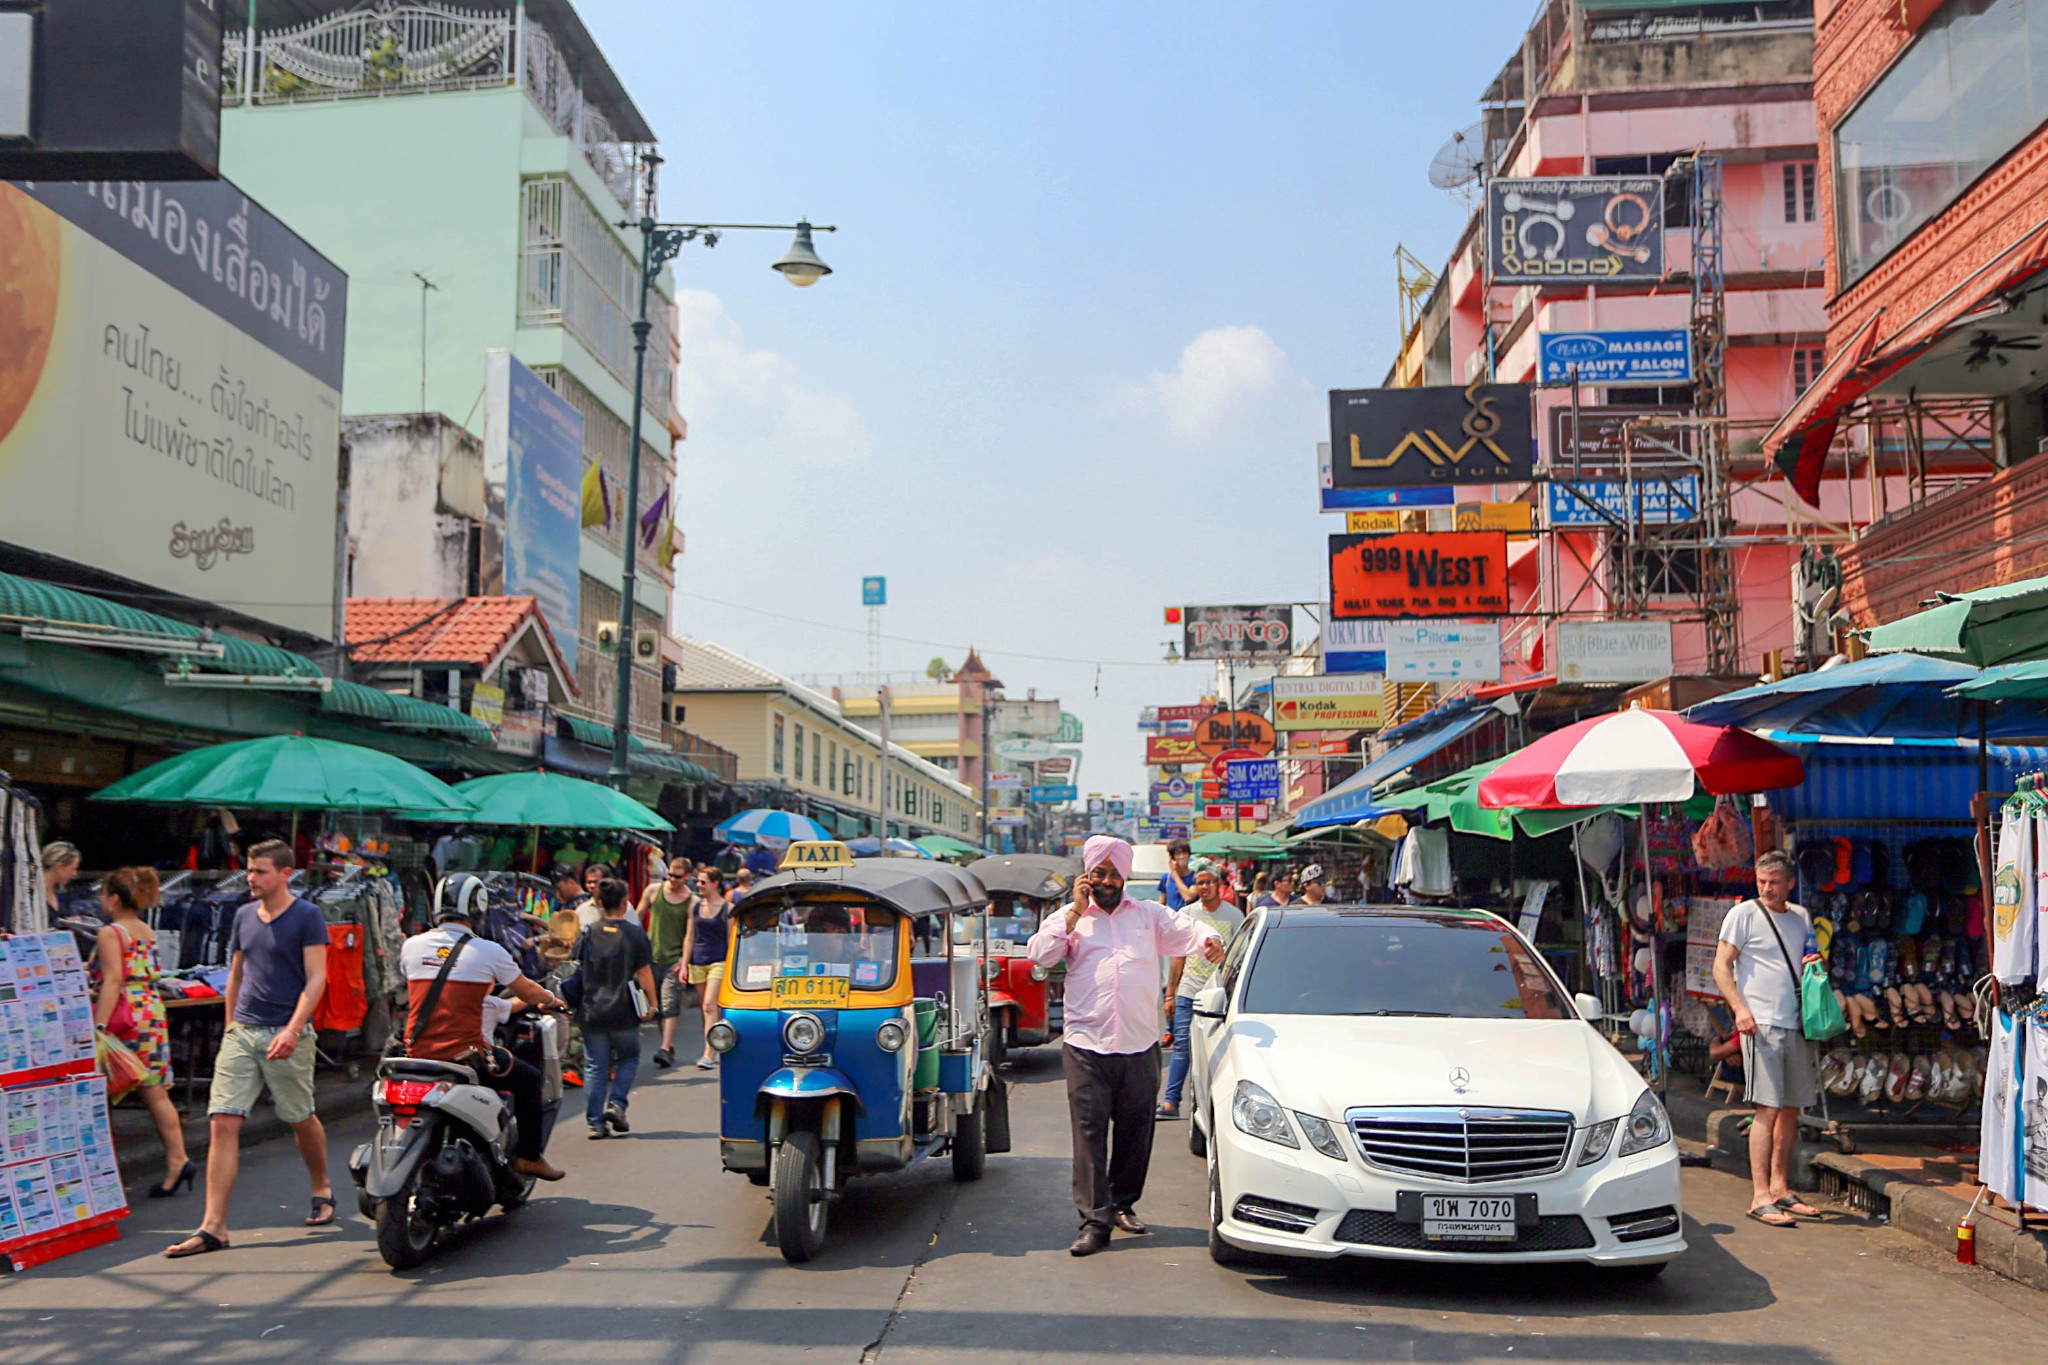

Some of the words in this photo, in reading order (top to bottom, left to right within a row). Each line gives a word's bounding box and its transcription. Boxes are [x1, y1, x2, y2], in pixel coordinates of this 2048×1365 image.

[1608, 340, 1684, 353] MASSAGE
[1631, 358, 1685, 371] SALON
[1352, 518, 1394, 531] Kodak
[1361, 548, 1401, 572] 999
[1187, 620, 1289, 646] TATTOO
[1275, 682, 1317, 694] CENTRAL
[1319, 681, 1357, 693] DIGITAL
[1360, 679, 1377, 691] LAB
[1299, 701, 1336, 711] Kodak
[1314, 710, 1378, 720] PROFESSIONAL
[1228, 764, 1247, 783] SIM
[1249, 763, 1278, 782] CARD
[1221, 807, 1236, 815] tru
[796, 846, 840, 862] TAXI
[806, 979, 846, 995] 6117
[1469, 1200, 1511, 1218] 7070
